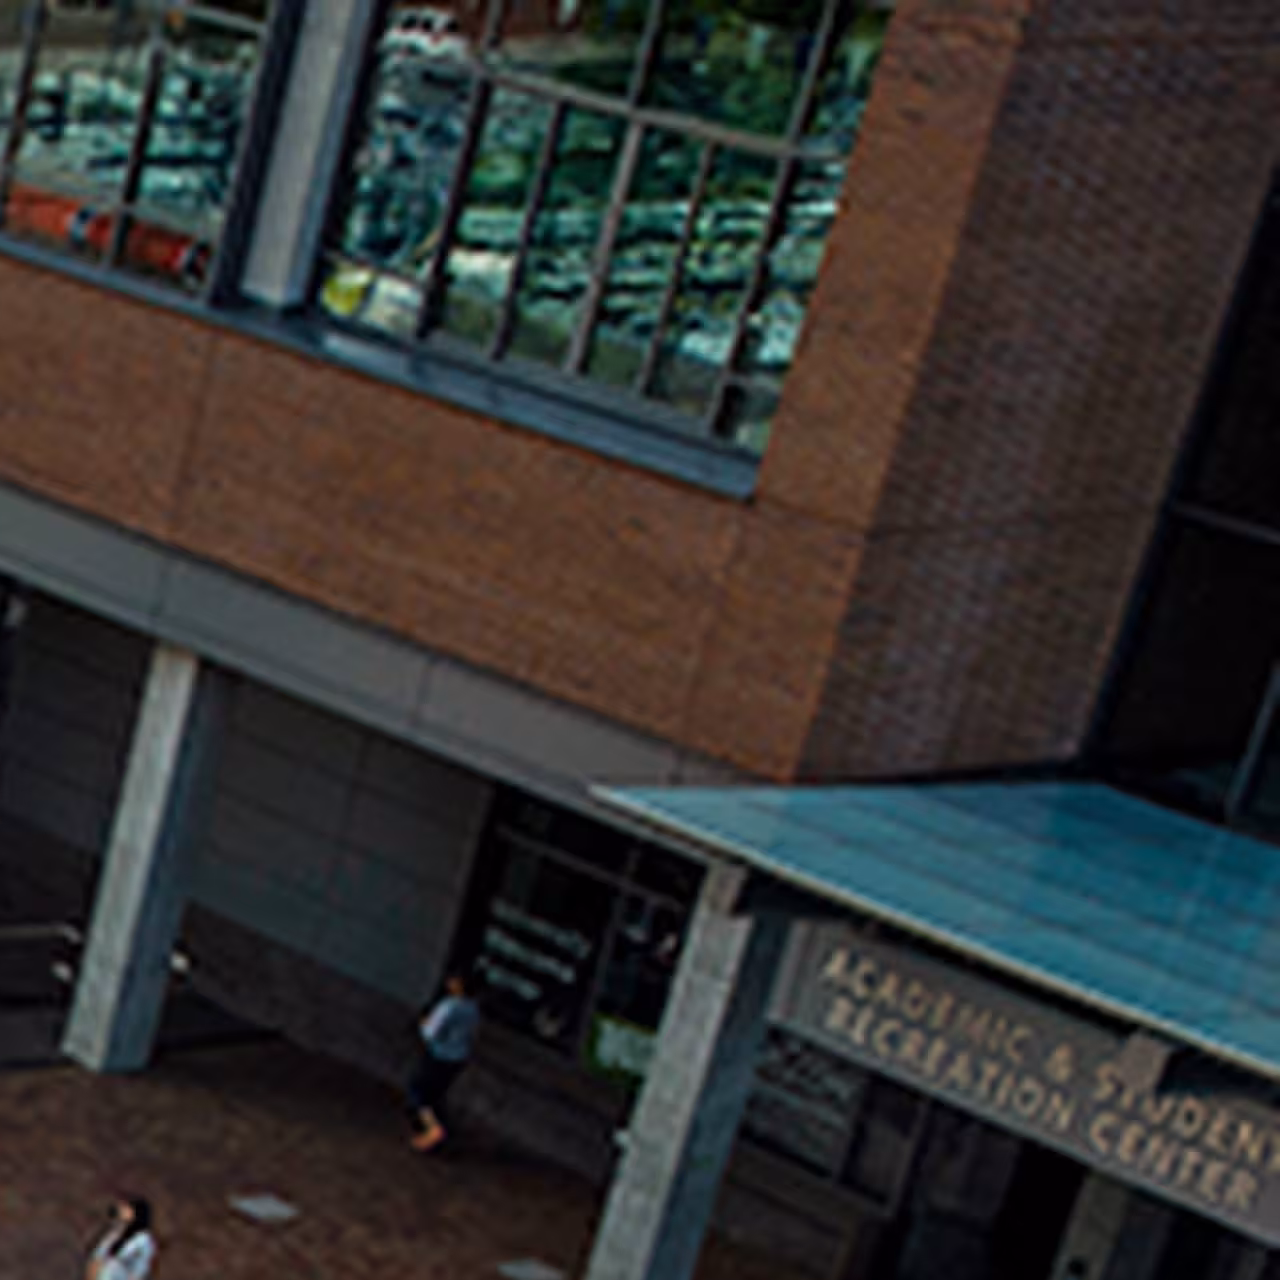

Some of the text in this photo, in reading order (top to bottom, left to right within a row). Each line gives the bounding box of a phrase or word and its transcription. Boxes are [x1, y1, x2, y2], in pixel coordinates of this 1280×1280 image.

[824, 949, 1032, 1062] ACADEMIC
[1046, 1044, 1078, 1083] &
[824, 996, 1075, 1132] RECREATION
[1088, 1110, 1259, 1211] CENTER
